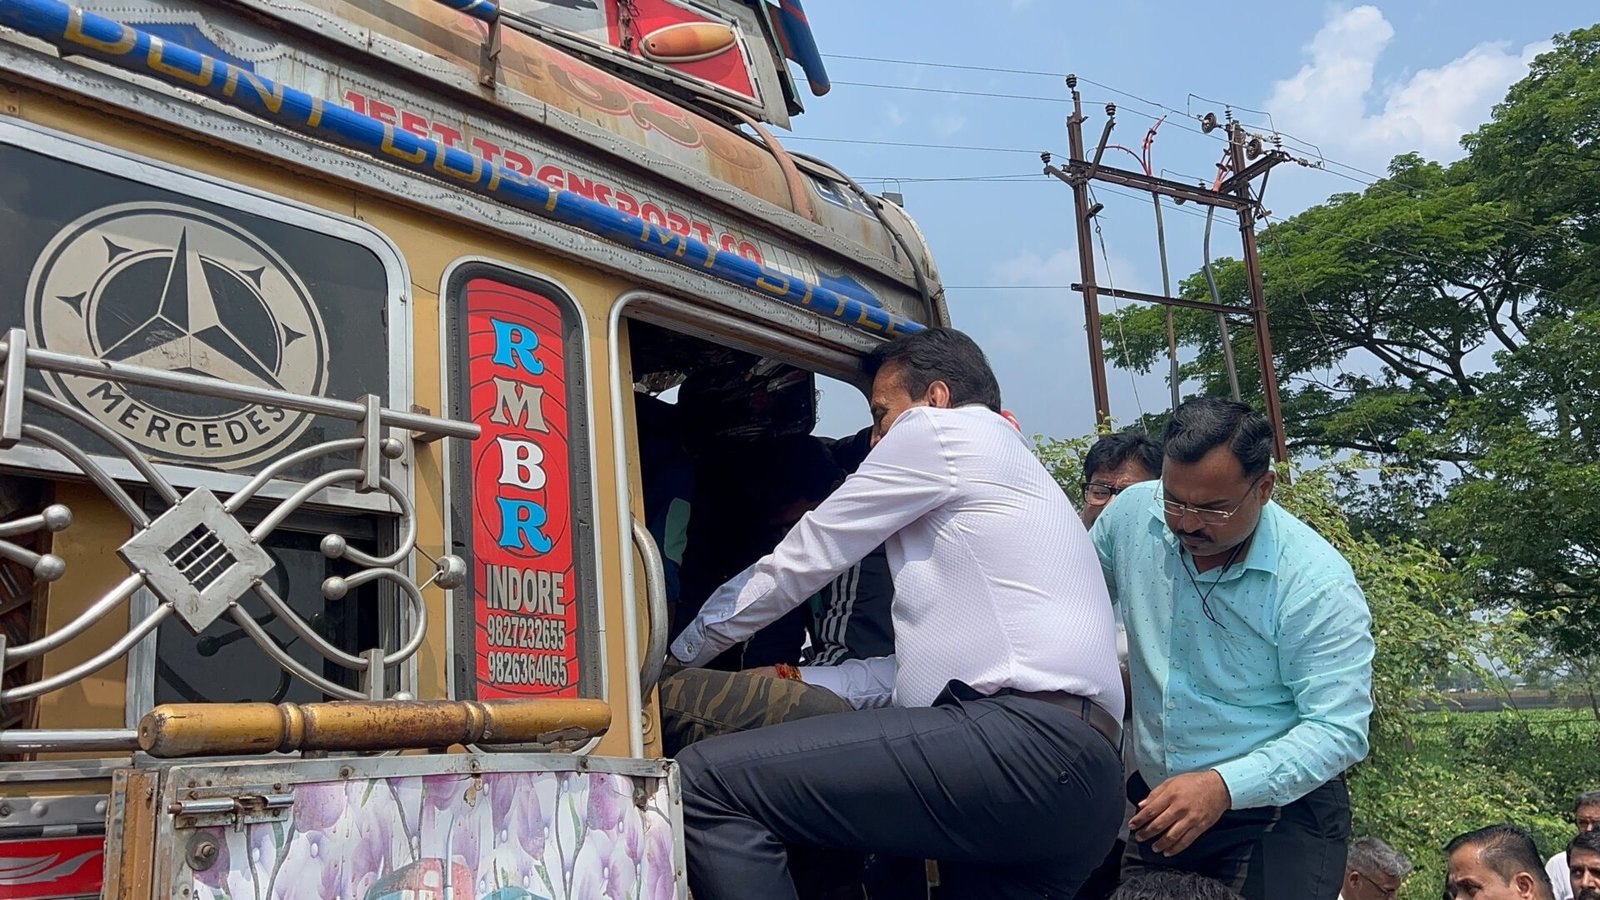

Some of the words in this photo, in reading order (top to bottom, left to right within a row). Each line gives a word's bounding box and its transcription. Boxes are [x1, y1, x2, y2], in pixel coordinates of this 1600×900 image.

[87, 381, 286, 449] MERCEDES
[485, 563, 566, 616] INDORE
[486, 613, 566, 651] 9827232655
[487, 650, 568, 687] 9826364055
